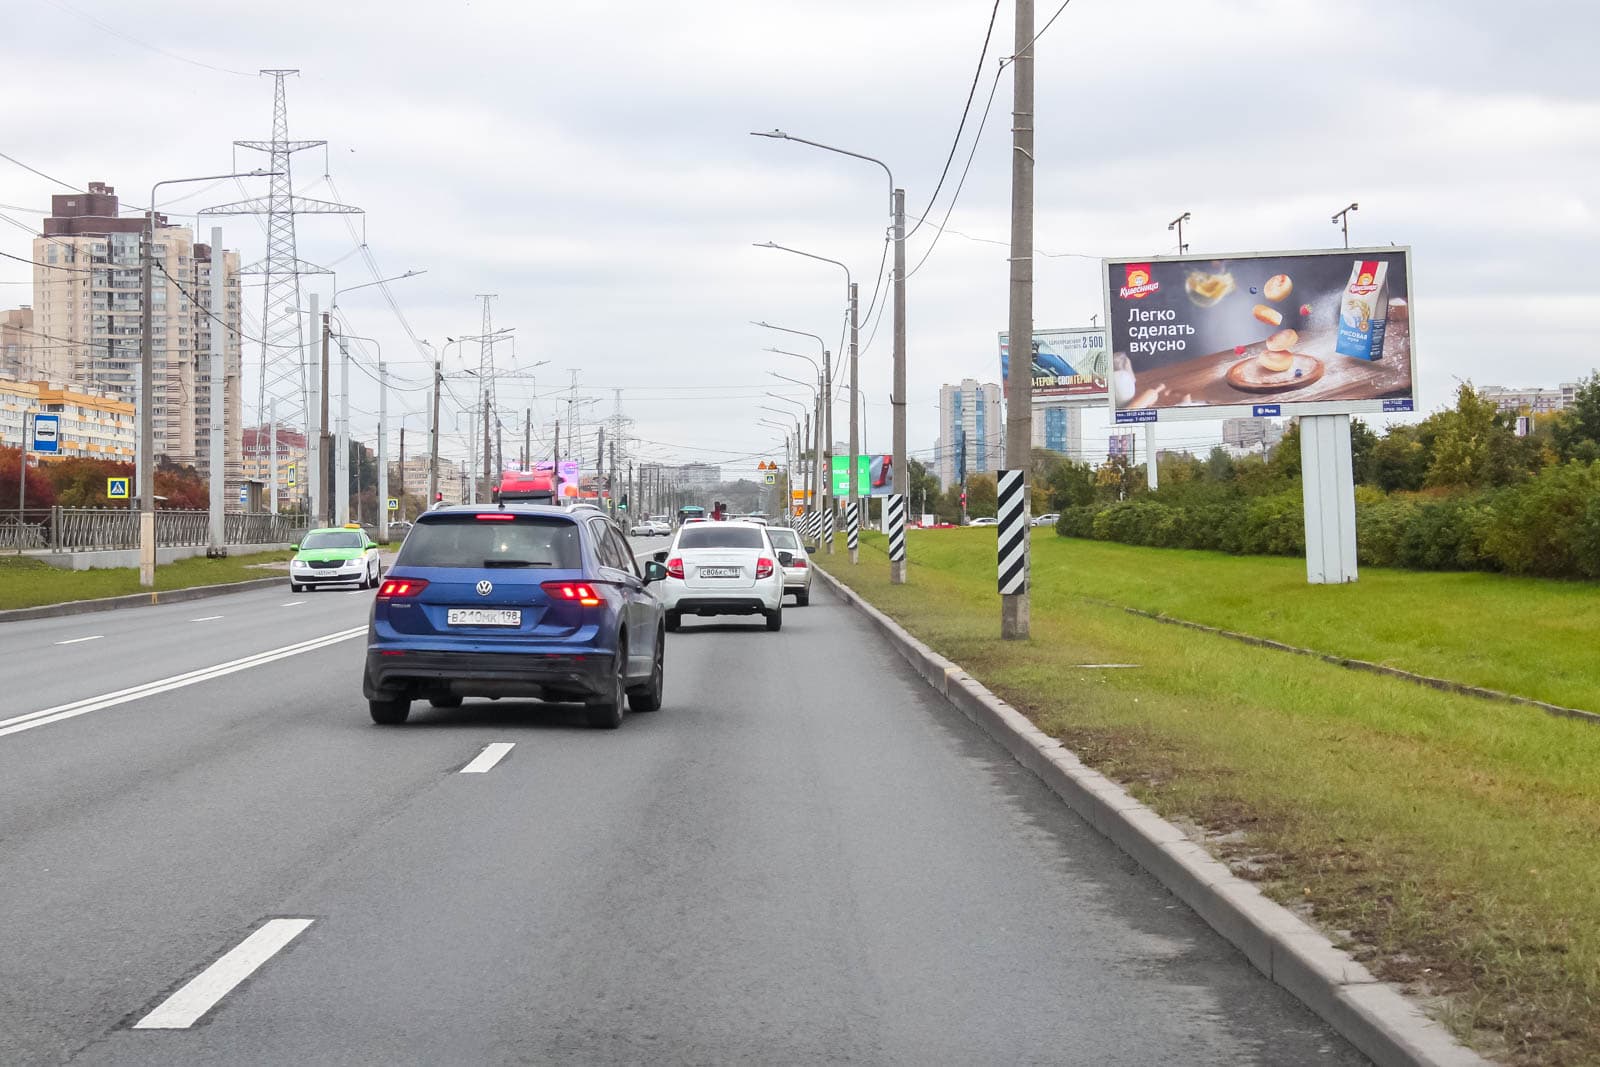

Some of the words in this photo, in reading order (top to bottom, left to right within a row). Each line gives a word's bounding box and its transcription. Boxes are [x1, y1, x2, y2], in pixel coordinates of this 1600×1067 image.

[1128, 308, 1176, 322] Легко
[1128, 324, 1196, 340] сделать
[1129, 339, 1186, 356] вкусно
